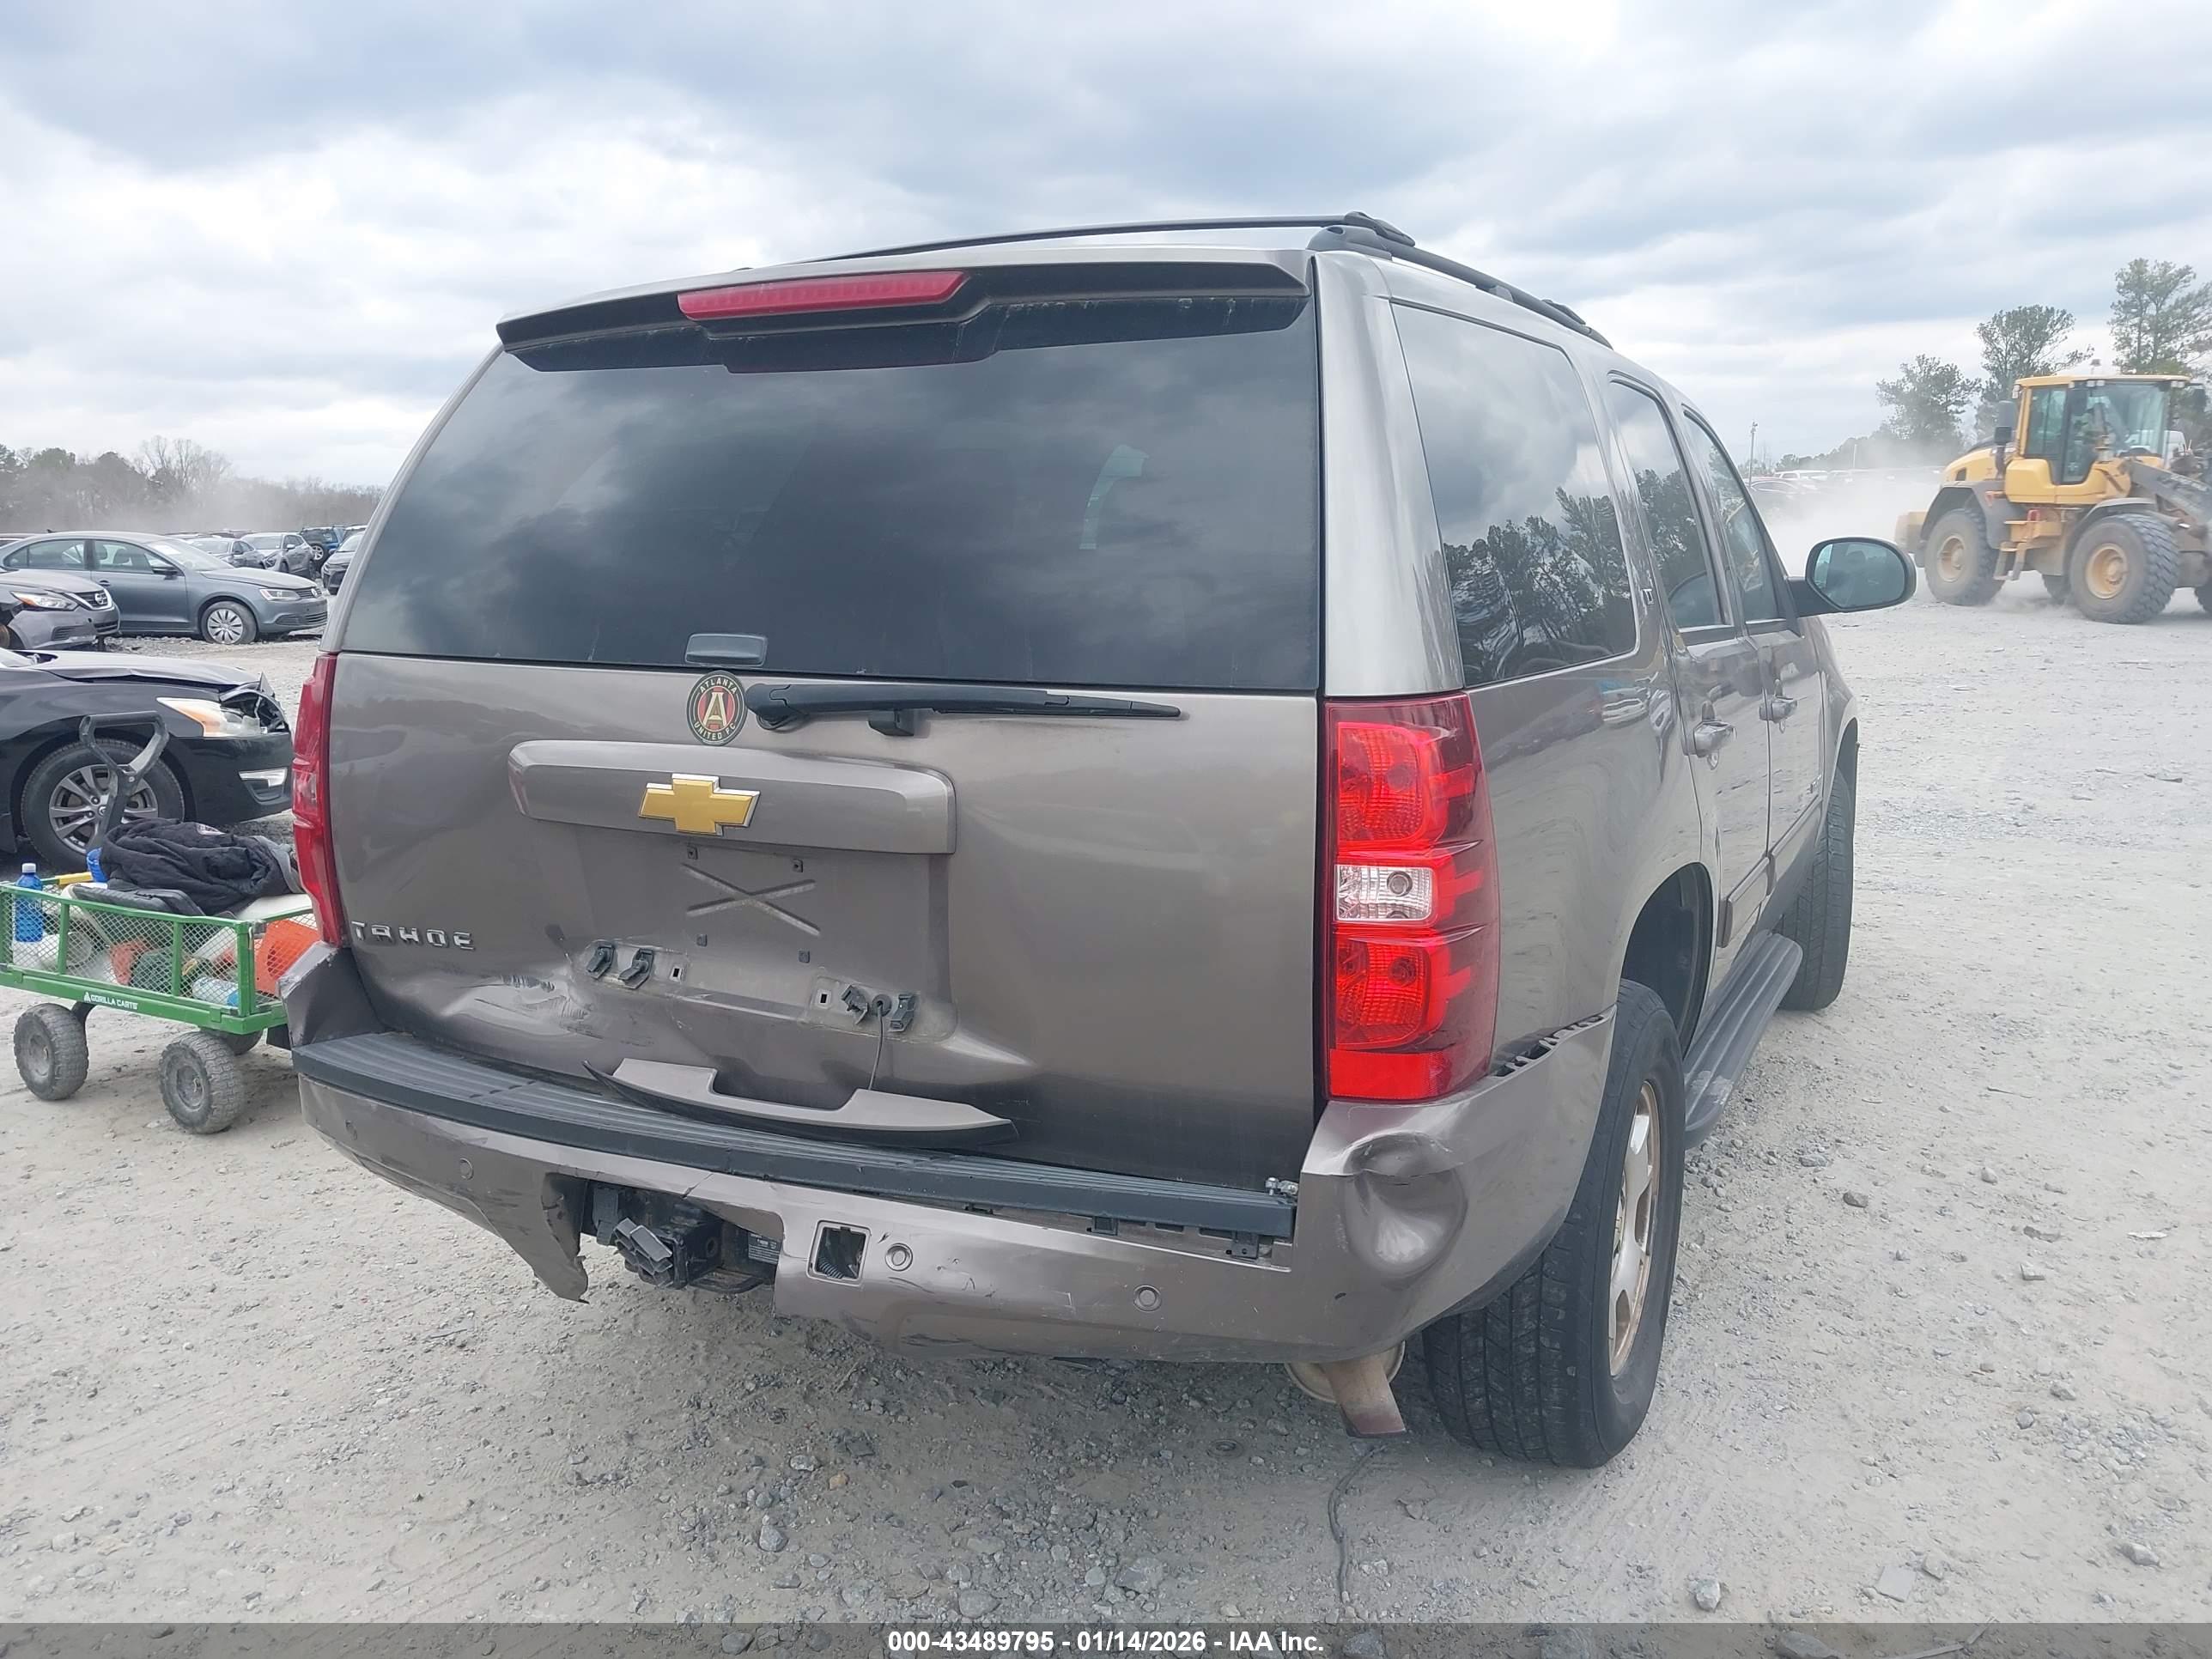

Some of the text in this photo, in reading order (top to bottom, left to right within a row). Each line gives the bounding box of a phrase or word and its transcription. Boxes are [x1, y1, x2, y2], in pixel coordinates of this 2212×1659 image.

[699, 677, 738, 695] ATLANTA
[694, 720, 736, 740] UNITED FC
[351, 921, 476, 951] TAHOE
[90, 994, 116, 1006] GORILLA
